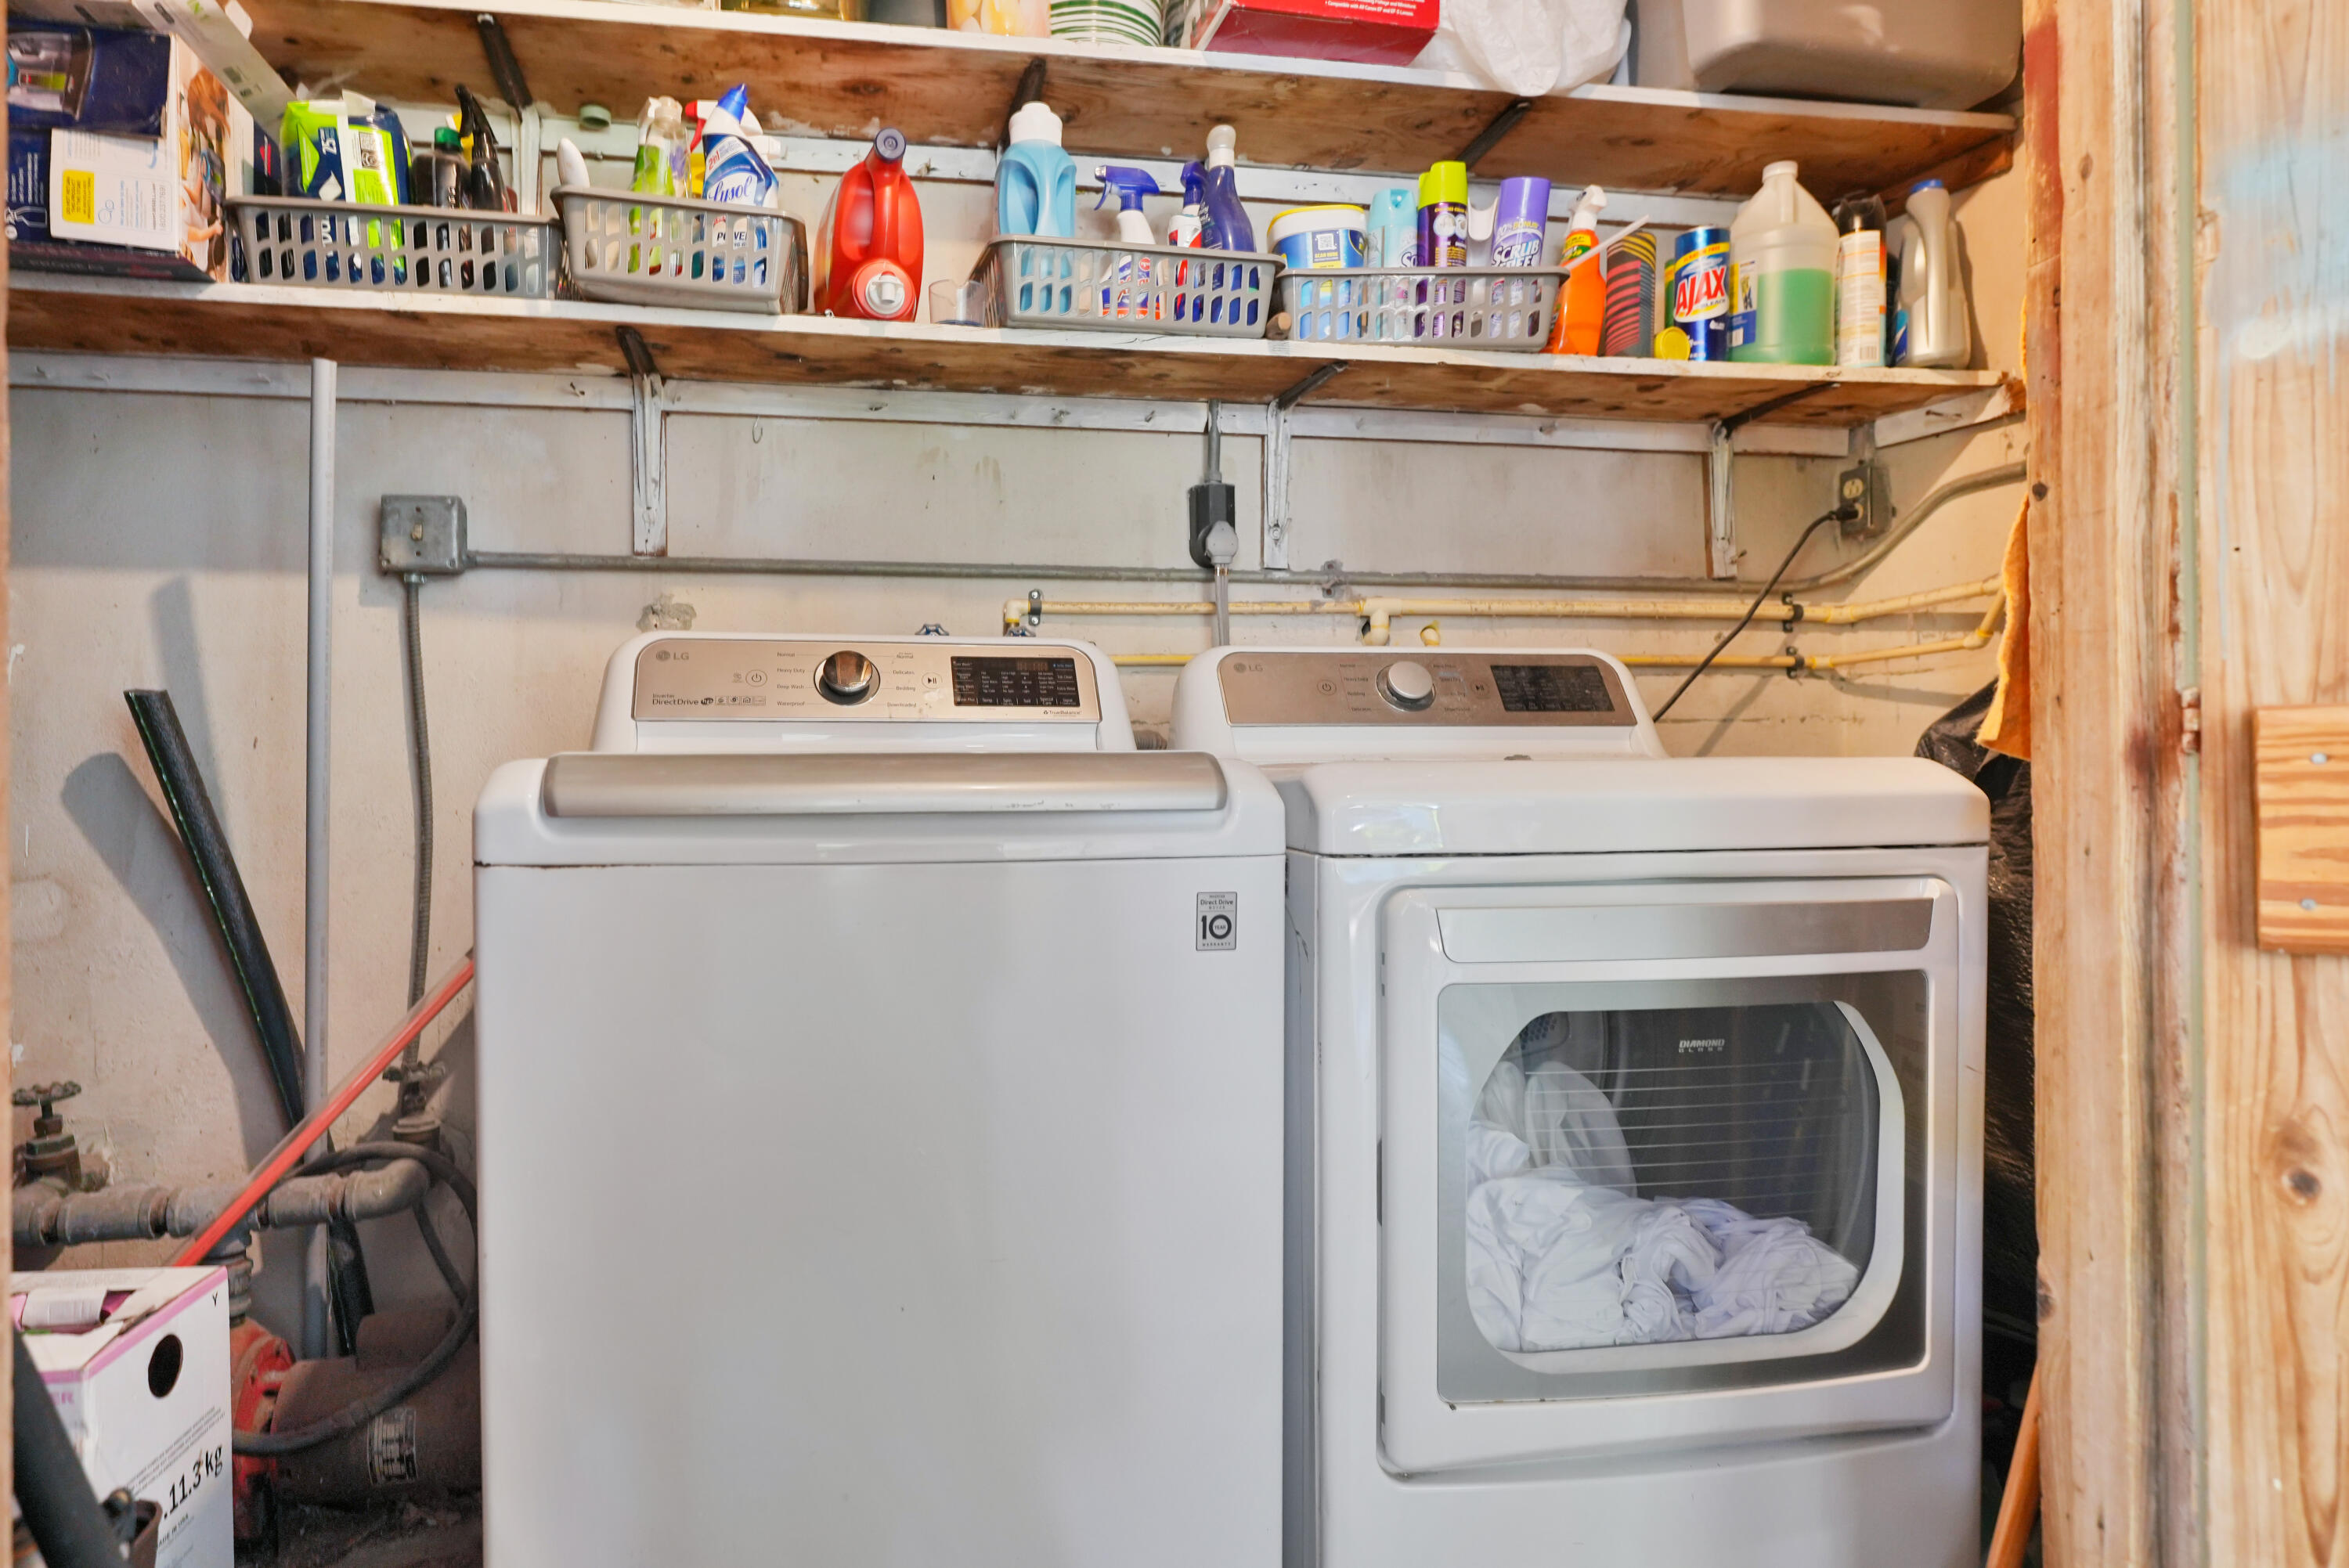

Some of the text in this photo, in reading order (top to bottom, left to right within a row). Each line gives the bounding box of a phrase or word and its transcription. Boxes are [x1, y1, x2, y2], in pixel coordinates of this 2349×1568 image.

[708, 150, 721, 171] 2in1
[708, 175, 752, 204] Lysol
[1491, 239, 1540, 267] SCRUB
[1675, 266, 1727, 317] AJAX
[673, 652, 689, 661] LG
[1201, 914, 1232, 940] 10
[1679, 1039, 1725, 1047] DIAMOND
[204, 1444, 223, 1478] kg
